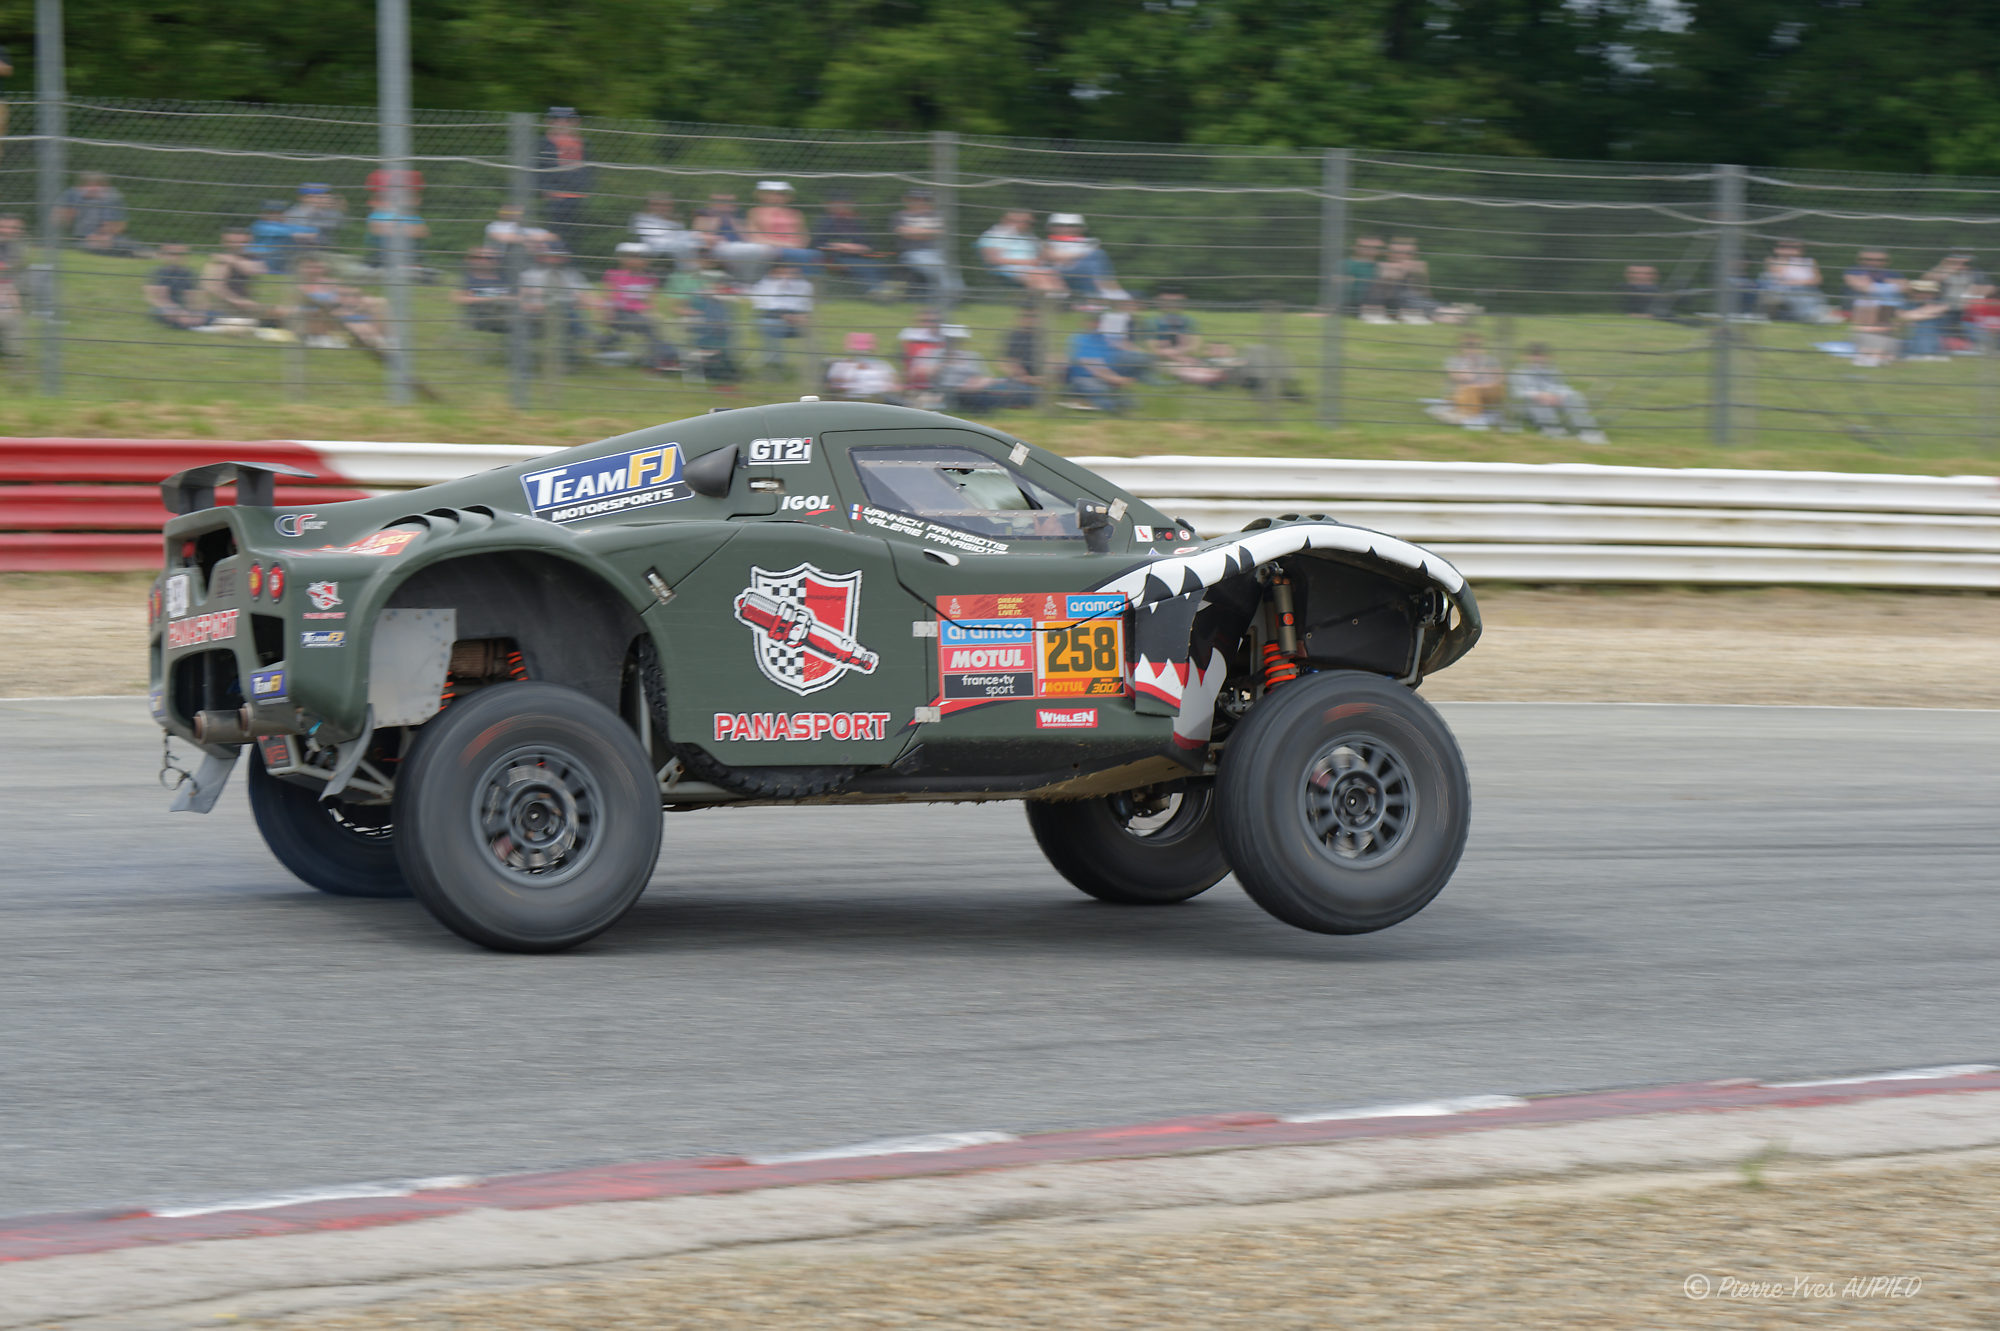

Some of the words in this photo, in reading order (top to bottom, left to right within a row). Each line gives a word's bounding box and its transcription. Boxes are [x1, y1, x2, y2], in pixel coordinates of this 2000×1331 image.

[750, 438, 812, 460] GT2i
[552, 488, 675, 522] MOTORSPORTS
[781, 495, 831, 510] IGOL
[862, 506, 925, 528] YANNICK
[926, 524, 1009, 551] PANAGIOTIS
[863, 515, 924, 537] VALERIE
[1070, 600, 1122, 612] aramco
[947, 623, 1026, 640] aramco
[950, 648, 1025, 669] MOTUL
[1047, 626, 1116, 673] 258
[985, 684, 1015, 697] sport
[1041, 681, 1085, 693] MOTUL
[714, 712, 891, 741] PANASPORT
[1038, 710, 1095, 723] WHELEN
